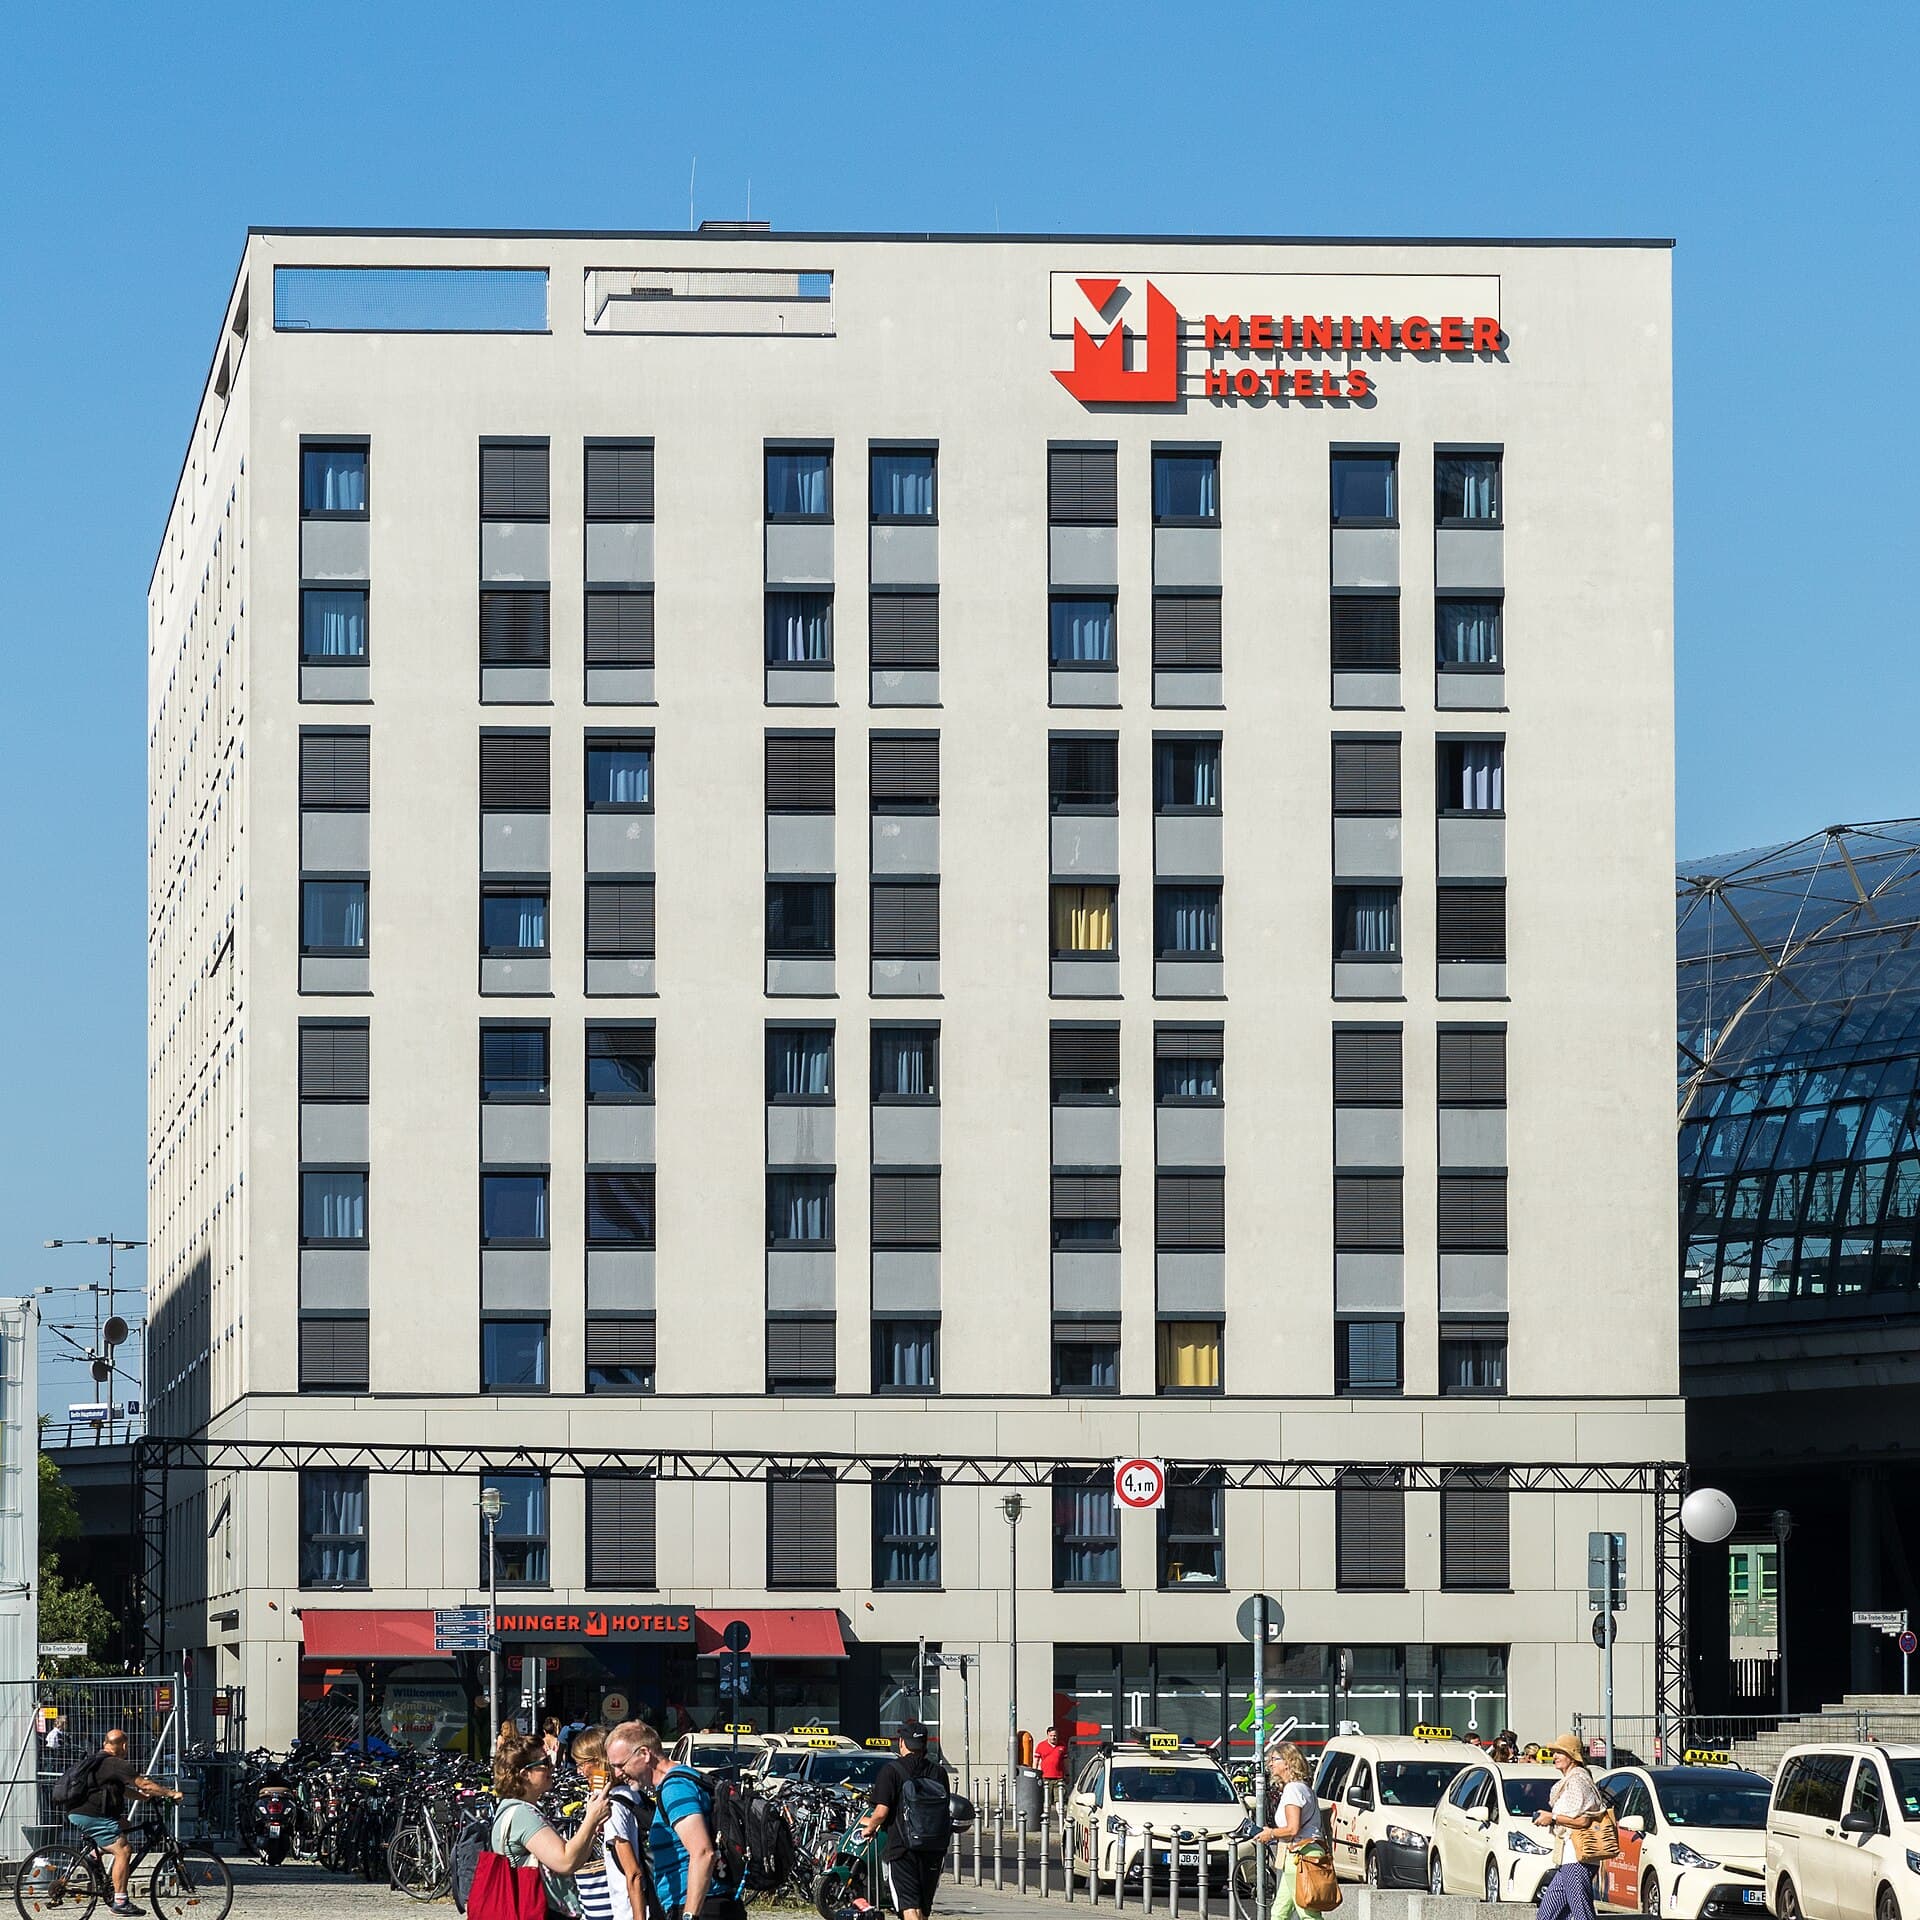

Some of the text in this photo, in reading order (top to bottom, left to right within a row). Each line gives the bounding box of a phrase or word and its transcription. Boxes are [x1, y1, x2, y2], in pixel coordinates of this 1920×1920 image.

[1204, 314, 1501, 351] MEININGER
[1204, 368, 1369, 398] HOTELS
[496, 1615, 581, 1631] ININGER
[612, 1615, 690, 1631] HOTELS
[393, 1687, 458, 1698] Willkommen
[1418, 1727, 1451, 1737] TAXI
[1152, 1738, 1177, 1746] TAXI
[1690, 1751, 1728, 1762] TAXI
